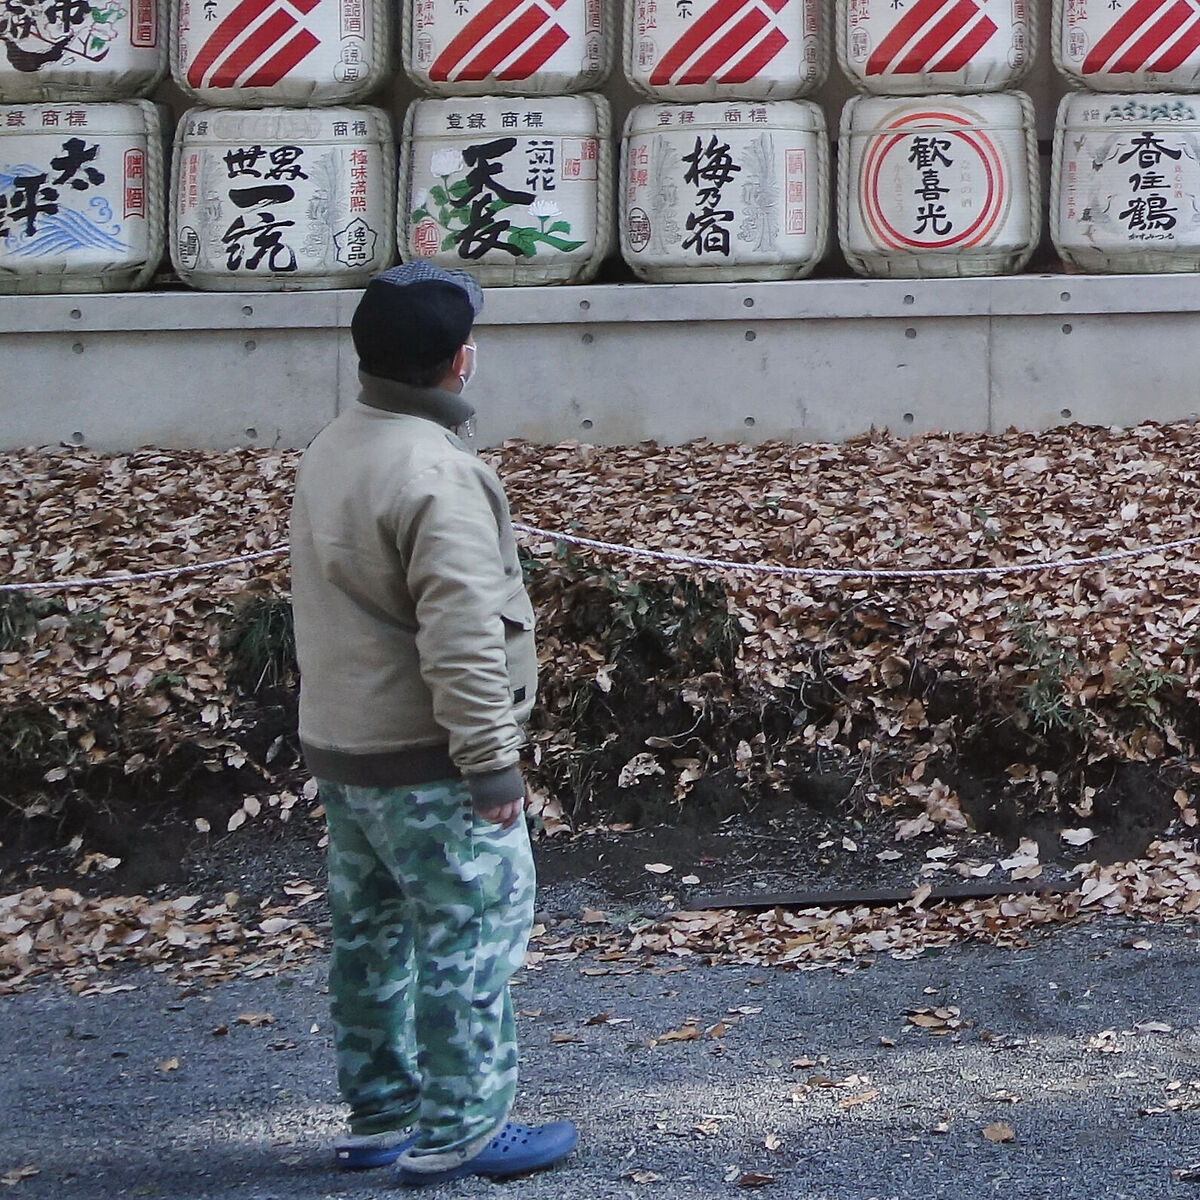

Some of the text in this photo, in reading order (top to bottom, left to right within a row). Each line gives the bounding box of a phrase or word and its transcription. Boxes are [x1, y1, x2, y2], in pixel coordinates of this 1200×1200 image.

[221, 145, 308, 272] 世界一統
[526, 141, 555, 191] 菊花
[682, 135, 741, 257] 梅乃宿
[1119, 130, 1182, 231] 香住鶴
[347, 230, 366, 262] 逸品
